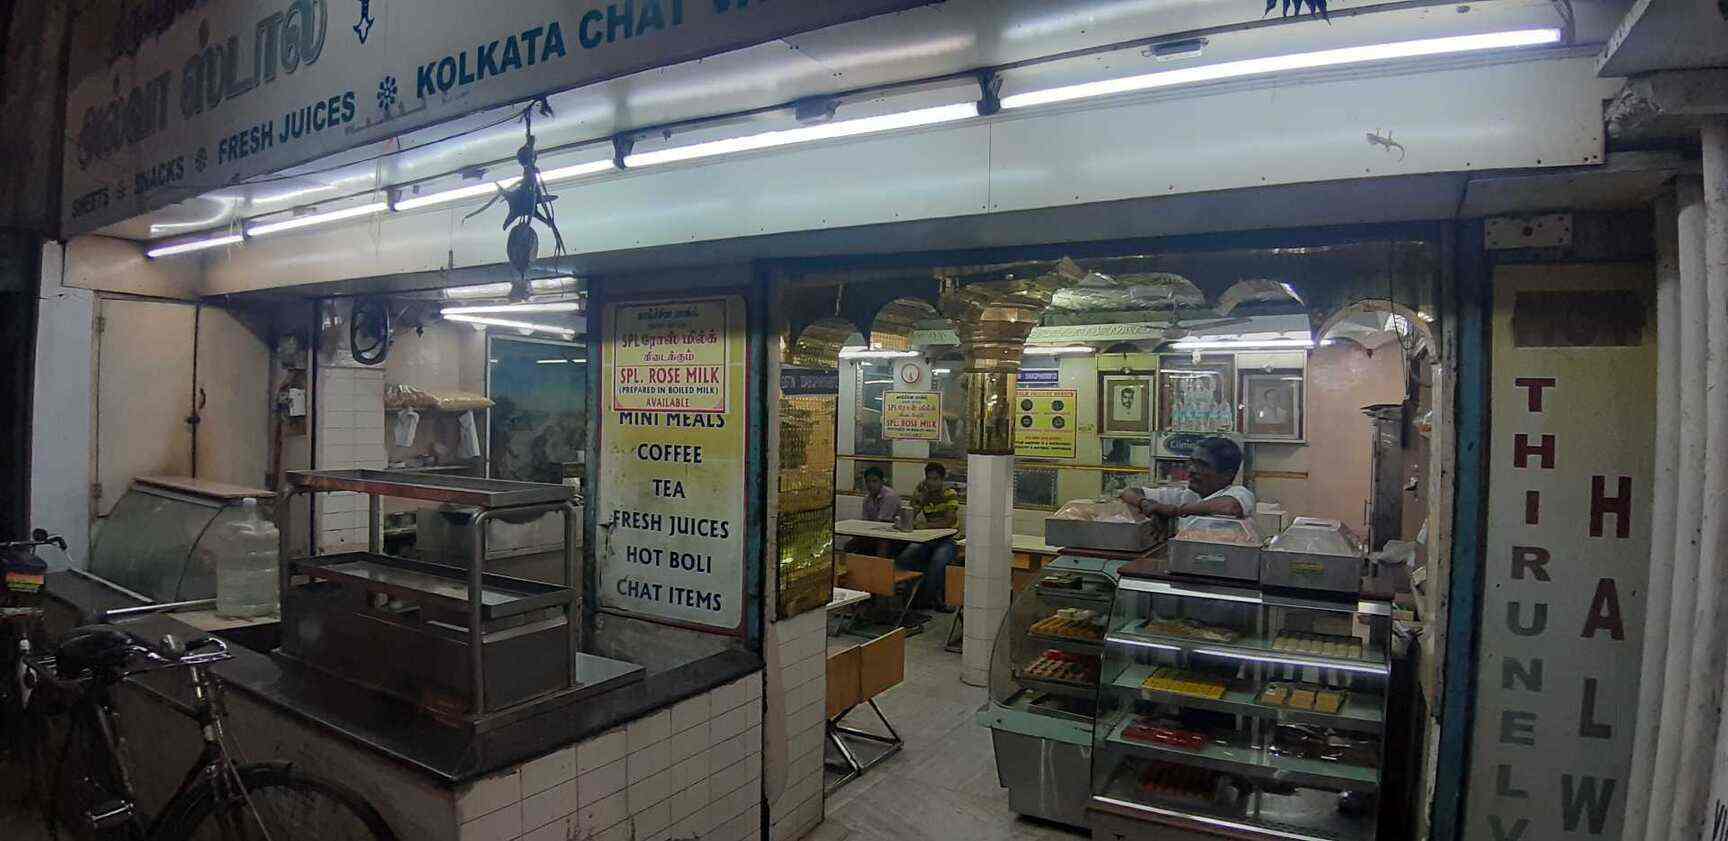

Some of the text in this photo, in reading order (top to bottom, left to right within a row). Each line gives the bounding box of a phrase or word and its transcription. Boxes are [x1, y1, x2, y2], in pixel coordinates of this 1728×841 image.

[135, 156, 185, 194] SNACKS
[218, 118, 274, 165] FRESH
[279, 90, 356, 143] JUICES
[416, 21, 567, 98] KOLKATA
[578, 0, 683, 50] CHAT
[621, 334, 640, 348] SPL
[620, 367, 720, 383] SPL. ROSE MILK
[657, 386, 666, 394] IN
[668, 386, 694, 394] BOILED
[696, 386, 719, 395] MILK)
[646, 398, 689, 408] AVAILABLE
[619, 412, 726, 428] MINI MEALS
[637, 443, 703, 464] COFFEE
[652, 479, 686, 499] TEA
[613, 510, 730, 539] FRESH JUICES
[626, 546, 712, 574] HOT BOLI
[616, 578, 722, 611] CHAT ITEMS
